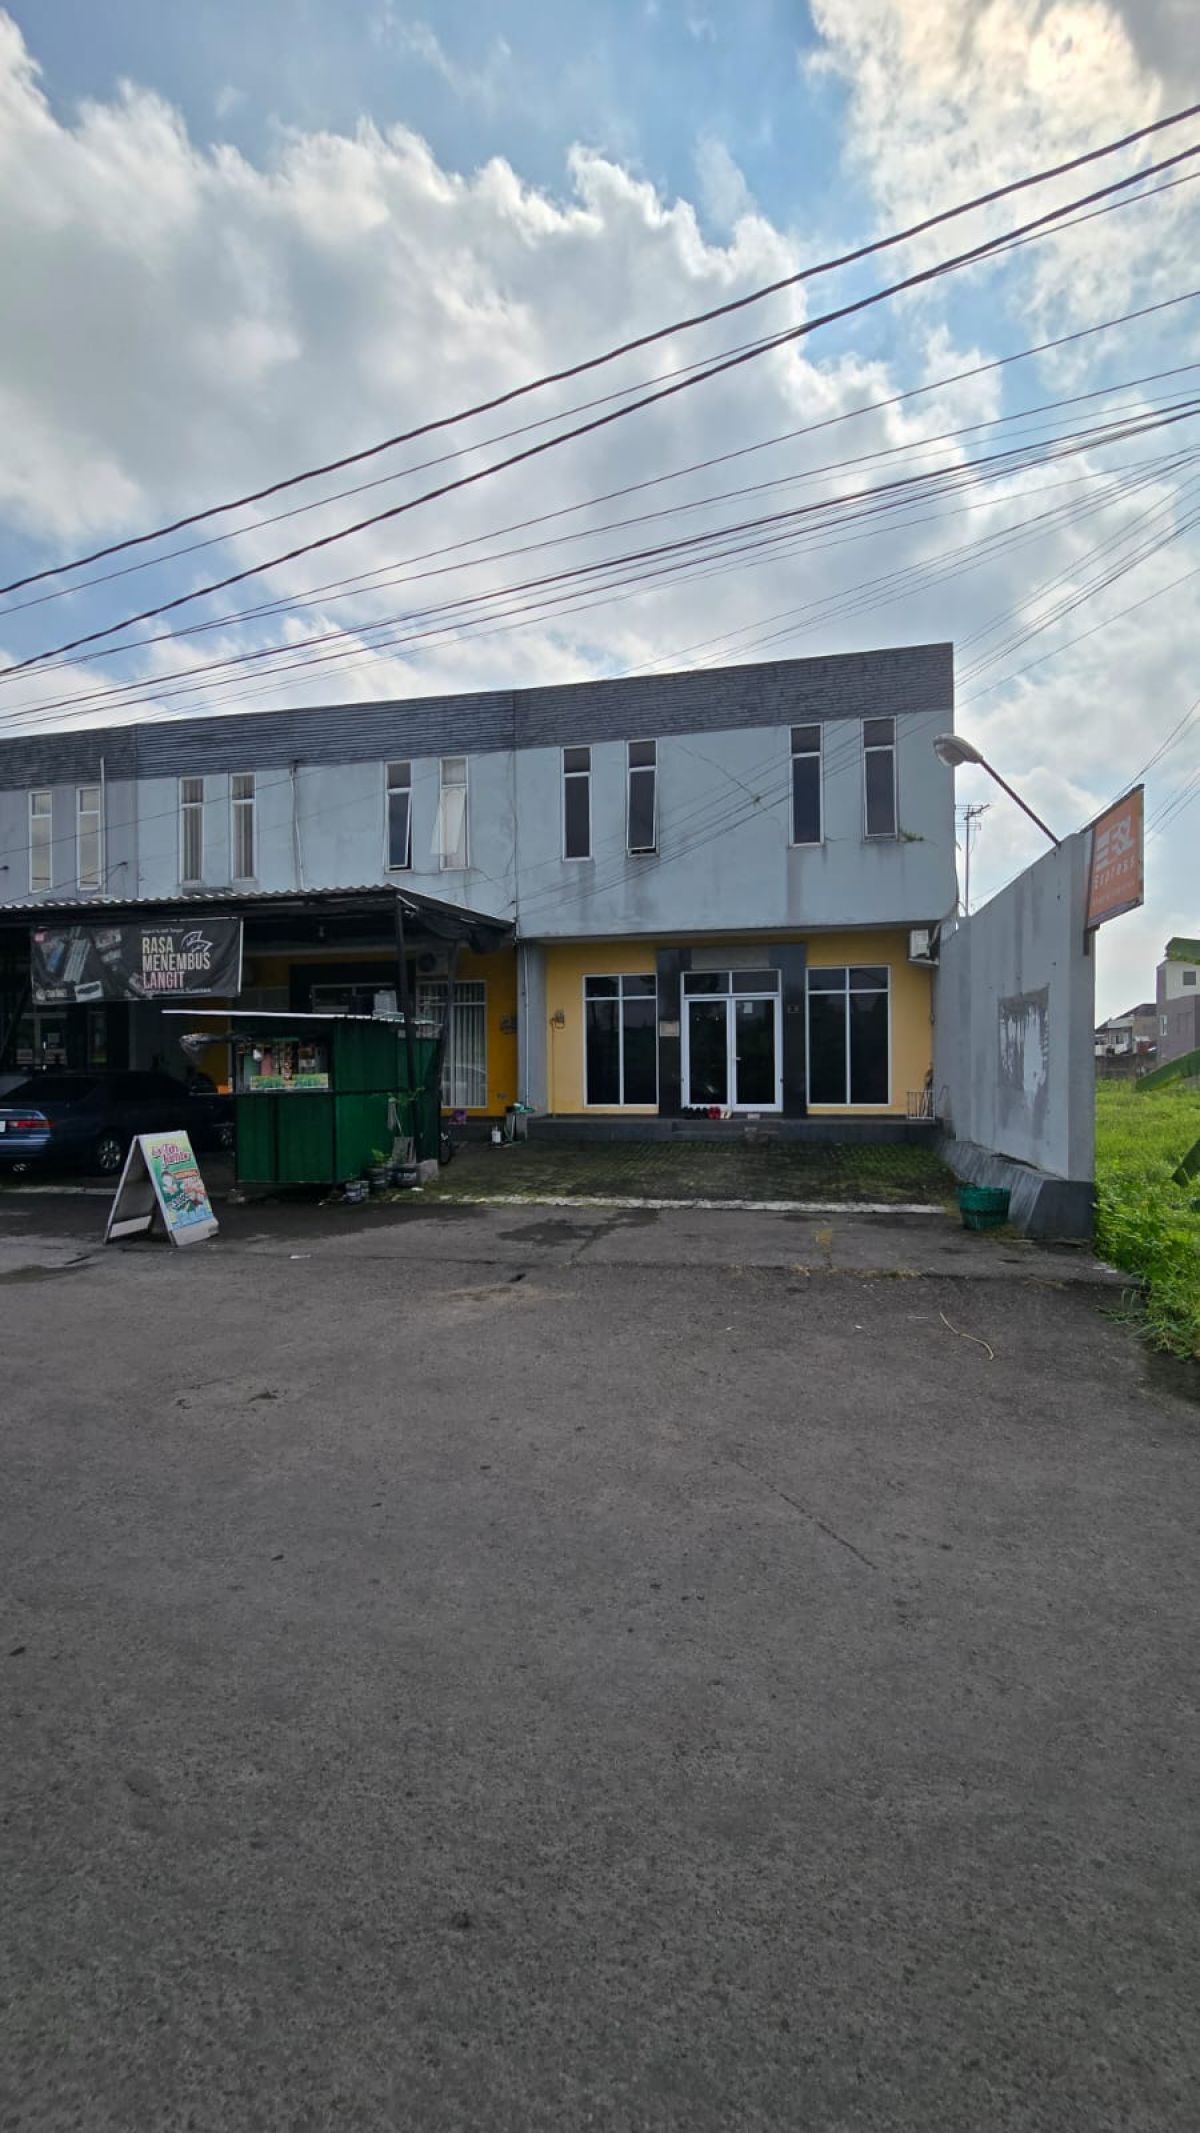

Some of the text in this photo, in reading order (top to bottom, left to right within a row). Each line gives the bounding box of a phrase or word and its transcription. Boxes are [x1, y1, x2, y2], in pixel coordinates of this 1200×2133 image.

[142, 936, 174, 954] RASA
[142, 952, 210, 971] MENEMBUS
[143, 971, 185, 989] LANGIT
